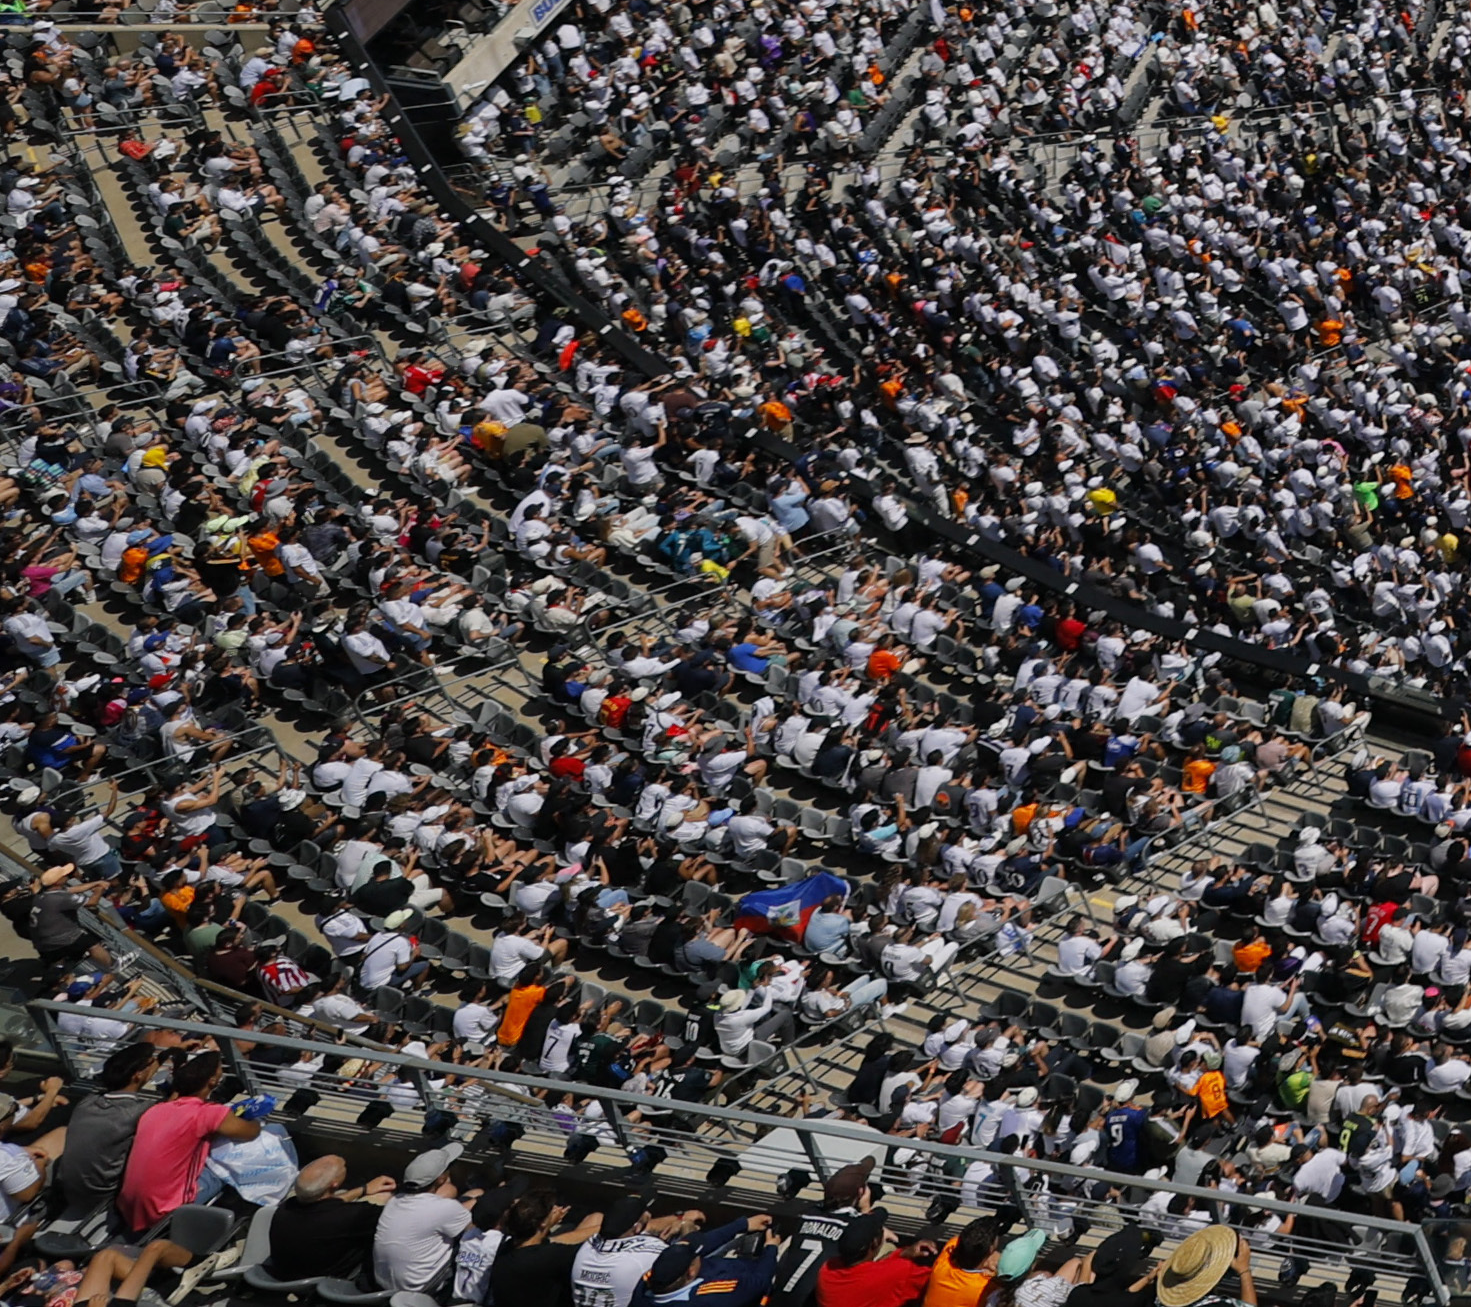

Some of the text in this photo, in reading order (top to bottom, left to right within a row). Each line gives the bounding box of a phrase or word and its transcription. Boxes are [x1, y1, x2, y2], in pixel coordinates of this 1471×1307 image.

[1110, 1123, 1123, 1147] 9
[800, 1222, 844, 1241] RONALDO
[783, 1239, 823, 1293] 7
